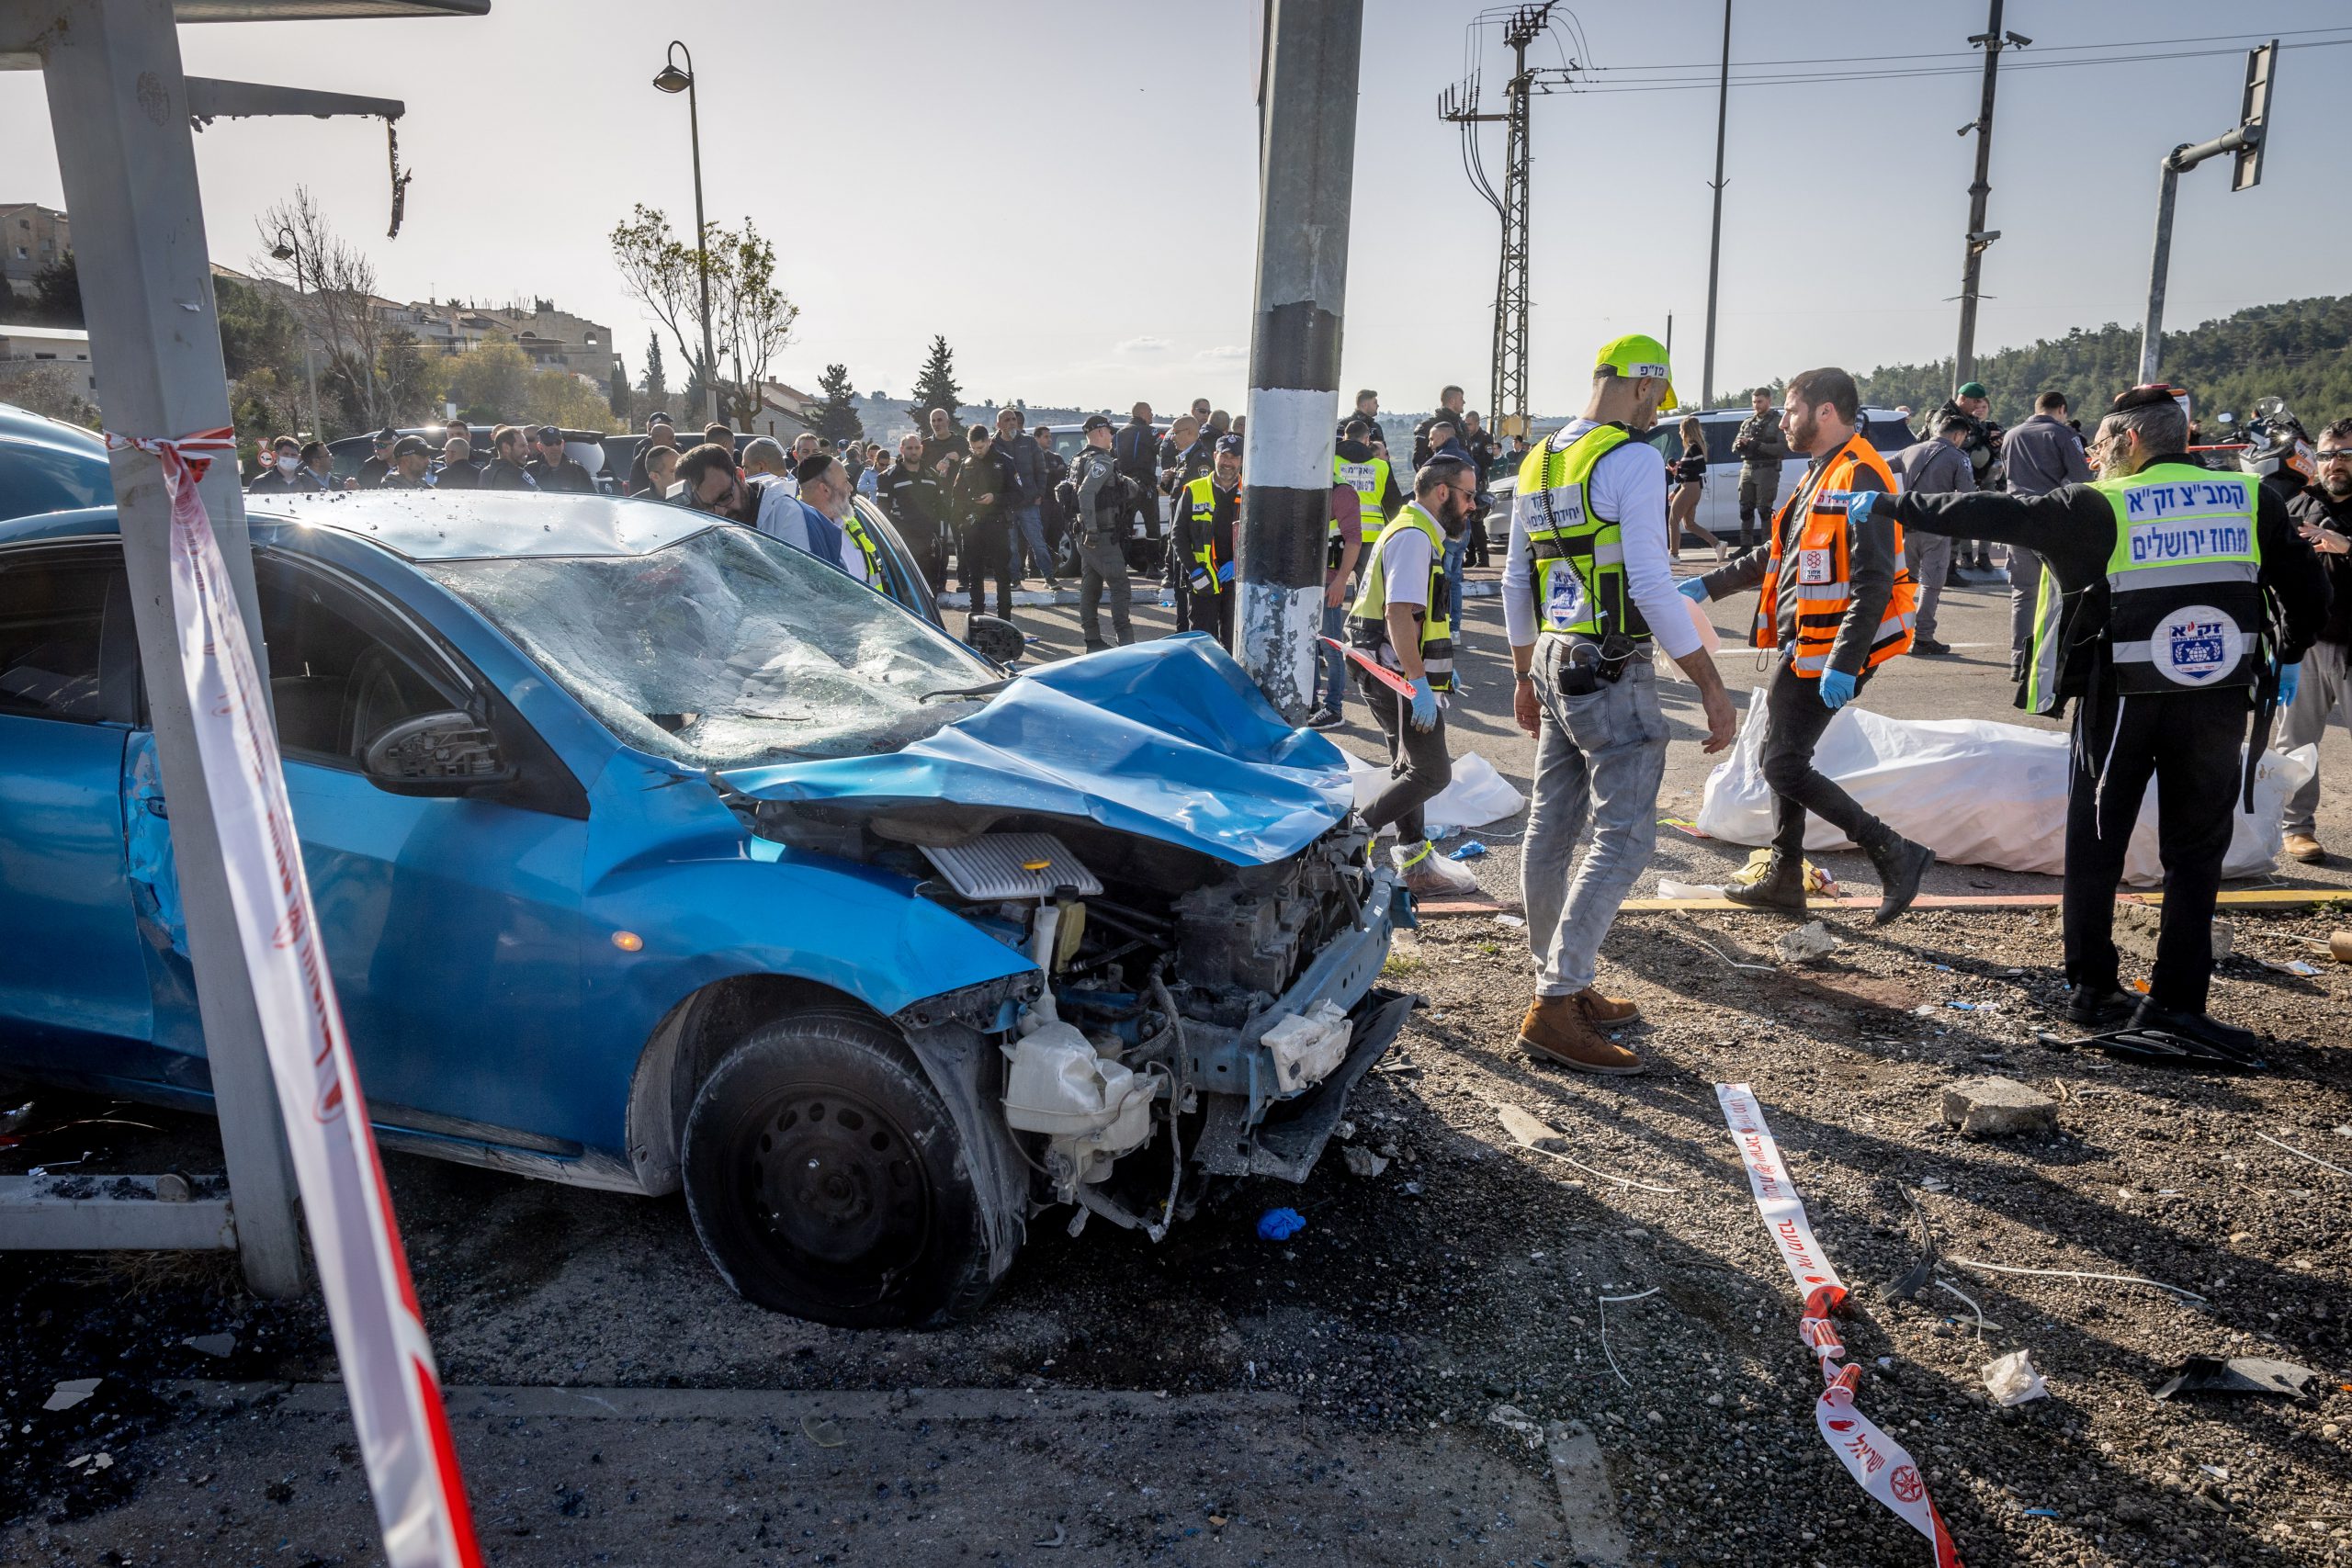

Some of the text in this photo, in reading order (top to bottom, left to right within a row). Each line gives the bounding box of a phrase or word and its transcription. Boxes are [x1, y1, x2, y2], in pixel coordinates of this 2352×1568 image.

[1531, 493, 1555, 512] מקד
[1553, 506, 1580, 523] יחידת
[2127, 484, 2245, 516] קמב"צ זק"א
[2132, 526, 2248, 560] מחוז ירושלים
[1778, 1218, 1815, 1269] אין מעבר
[1843, 1432, 1886, 1473] ישראל
